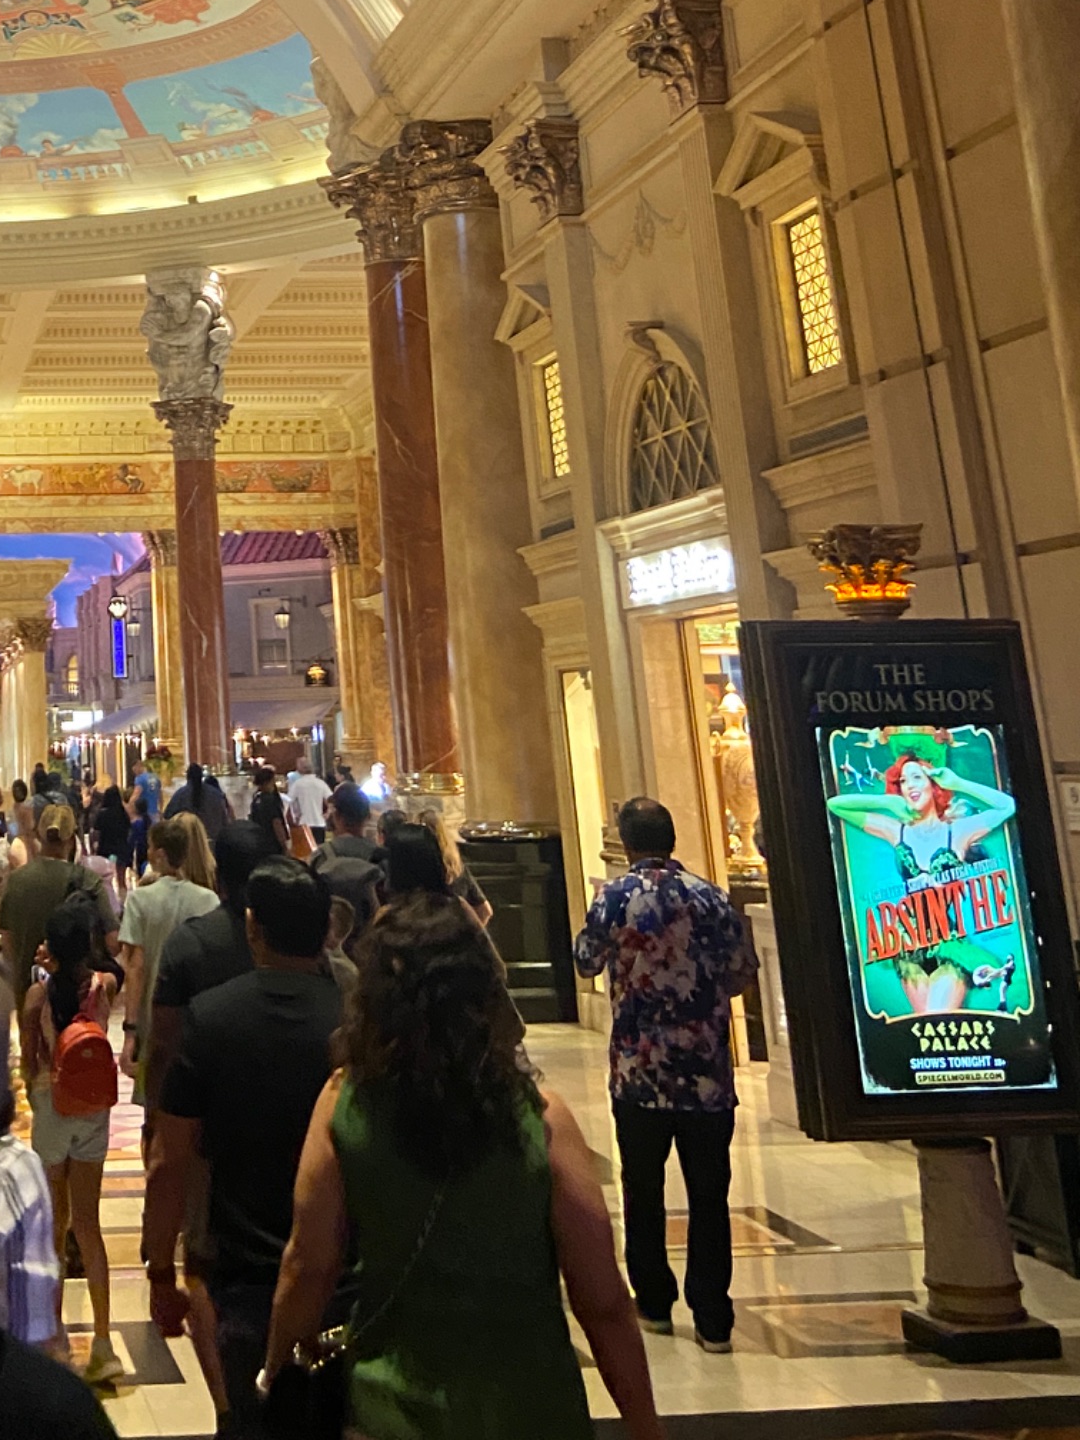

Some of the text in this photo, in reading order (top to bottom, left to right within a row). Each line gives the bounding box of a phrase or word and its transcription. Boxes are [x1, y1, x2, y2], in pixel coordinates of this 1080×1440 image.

[873, 663, 927, 686] THE
[815, 688, 996, 713] FORUM SHOPS
[865, 868, 1015, 964] ABSINTHE
[910, 1019, 996, 1038] CAESARS
[919, 1035, 993, 1052] PALACE
[909, 1056, 947, 1070] SHOWS
[947, 1055, 993, 1068] TONIGHT
